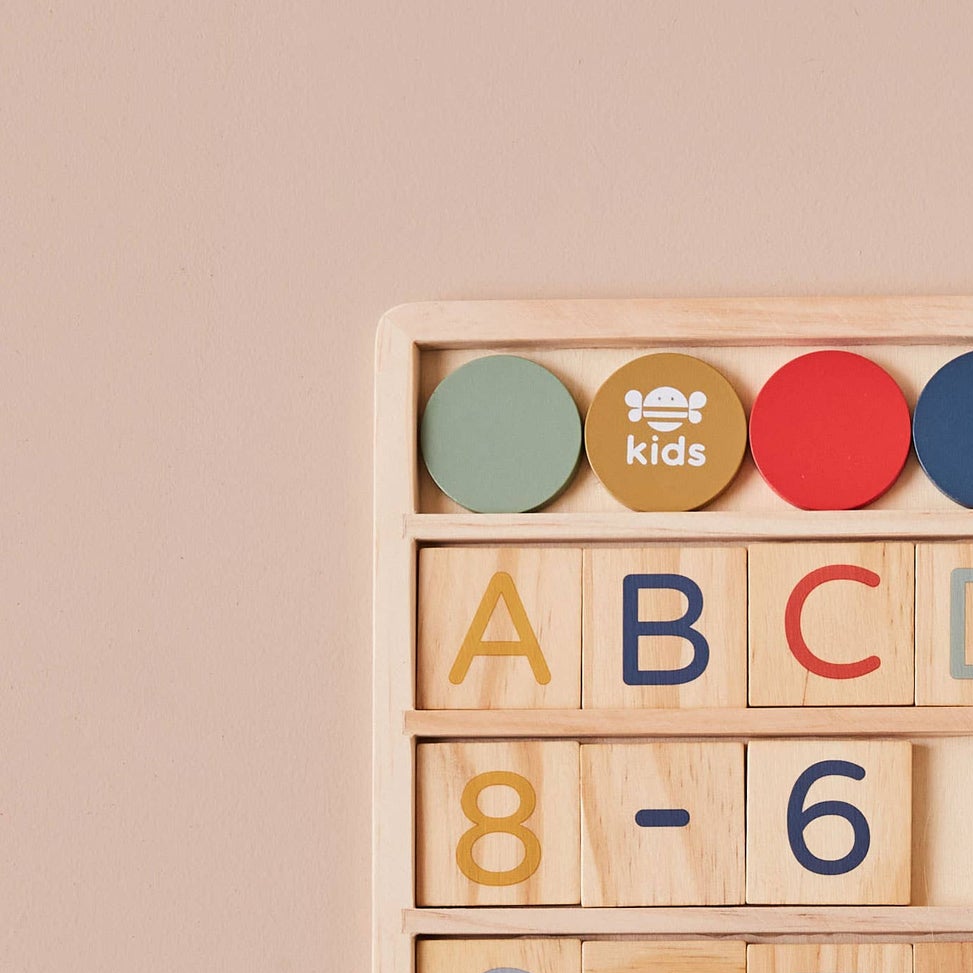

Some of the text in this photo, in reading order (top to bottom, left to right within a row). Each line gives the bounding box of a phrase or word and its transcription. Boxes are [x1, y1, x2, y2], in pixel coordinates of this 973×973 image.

[627, 433, 706, 467] kids
[456, 771, 542, 886] 8
[787, 760, 870, 875] 6
